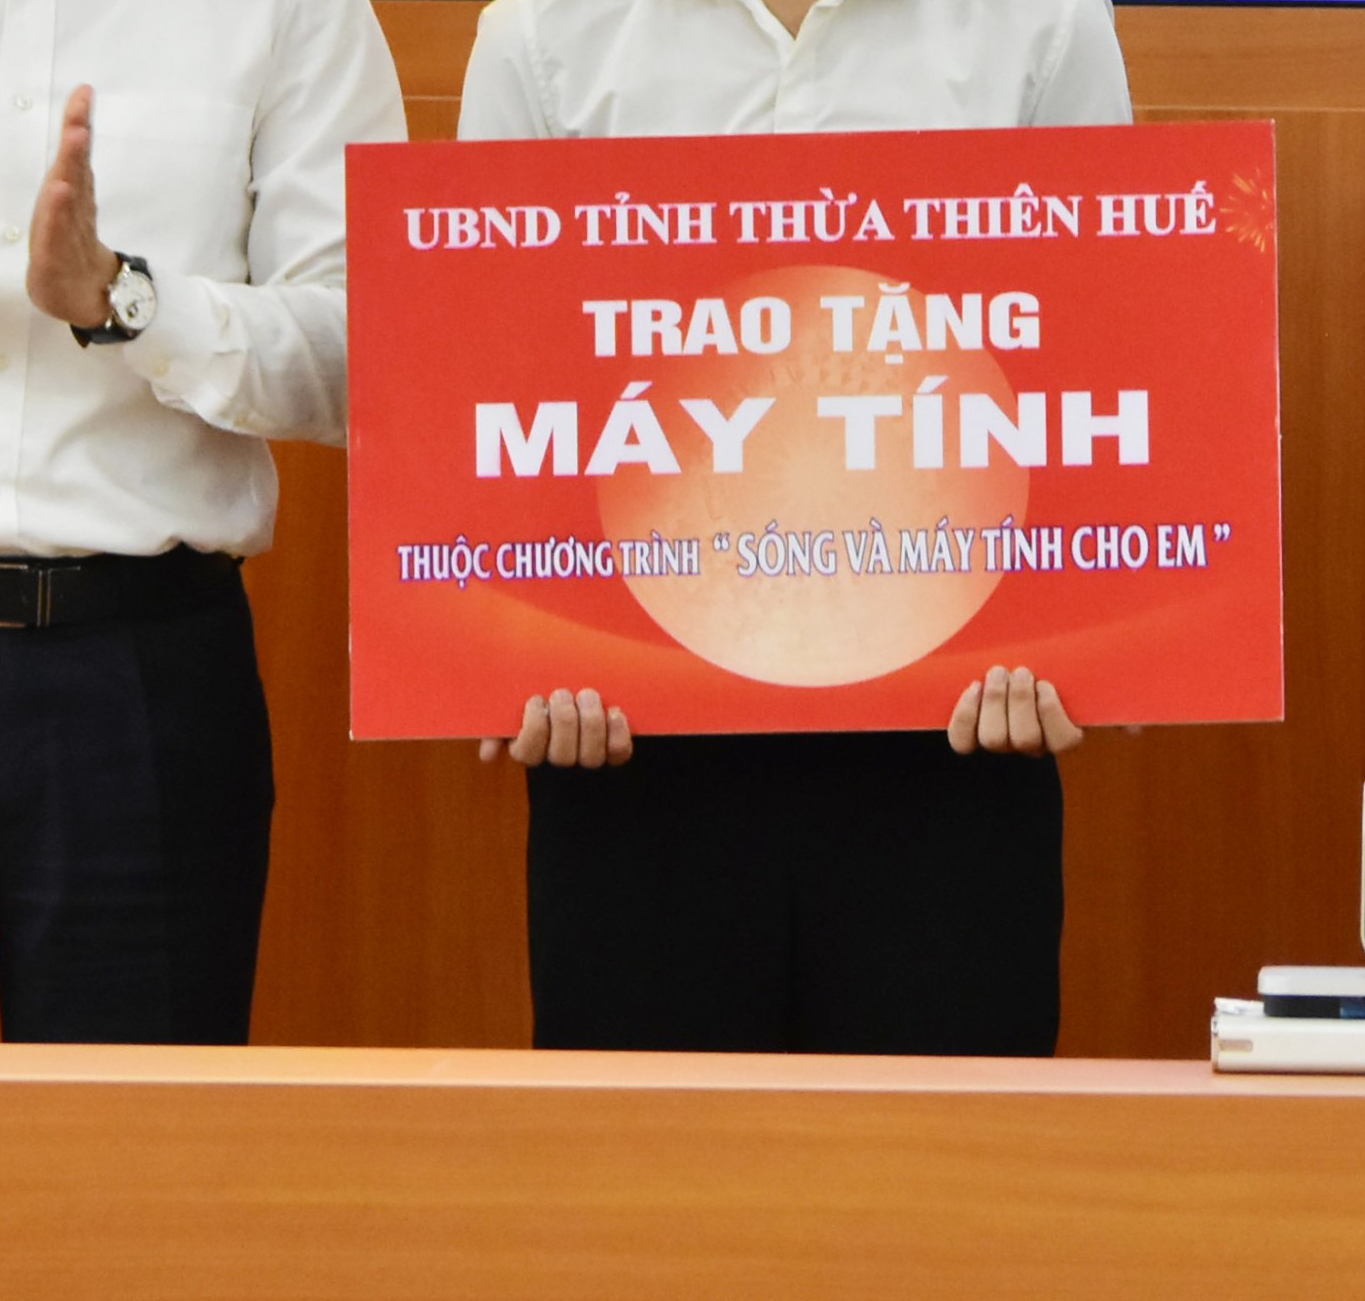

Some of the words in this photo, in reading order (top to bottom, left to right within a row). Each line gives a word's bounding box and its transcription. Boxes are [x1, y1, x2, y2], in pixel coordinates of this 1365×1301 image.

[407, 207, 561, 249] UBND
[575, 193, 714, 245] TỈNH
[730, 188, 892, 242] THỪA
[904, 184, 1080, 239] THIÊN
[1101, 181, 1216, 236] HUẾ
[583, 297, 792, 356] TRAO
[821, 283, 1040, 365] TẶNG
[476, 382, 775, 477] MÁY
[817, 375, 1149, 471] TÍNH
[398, 536, 492, 588] THUỘC
[496, 537, 614, 579] CHƯƠNG
[618, 532, 701, 577] TRÌNH
[842, 517, 896, 576] VÀ
[898, 518, 976, 574] MÁY
[981, 517, 1064, 572] TÍNH
[1072, 526, 1150, 570] CHO
